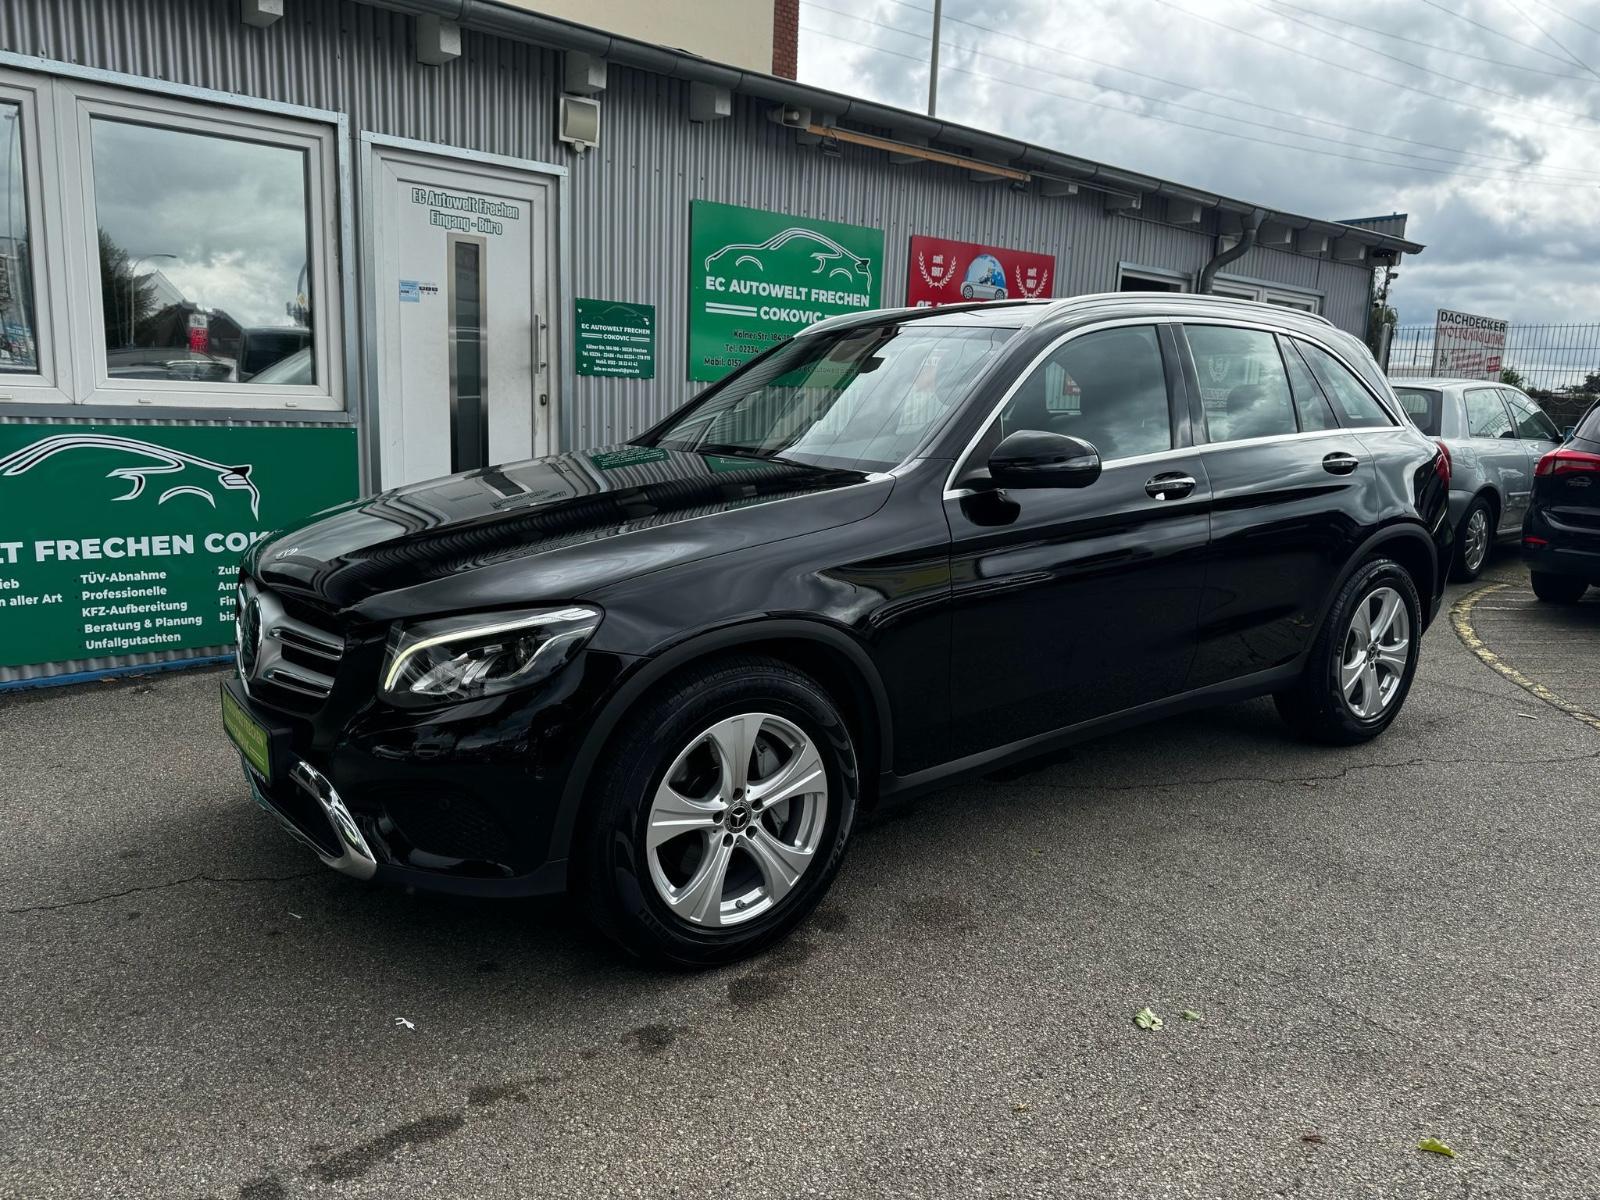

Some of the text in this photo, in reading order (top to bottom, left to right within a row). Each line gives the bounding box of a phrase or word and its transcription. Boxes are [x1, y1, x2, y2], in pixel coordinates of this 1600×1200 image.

[412, 187, 519, 220] EC Autowelt Frechen
[430, 209, 471, 232] Eingang
[478, 217, 503, 235] Büro
[705, 276, 870, 307] EC AUTOWELT FRECHEN
[760, 306, 822, 324] COKOVIC
[1440, 311, 1506, 333] DACHDECKER
[591, 325, 623, 333] AUTOWELT
[623, 327, 651, 335] FRECHEN
[35, 535, 194, 562] FRECHEN
[80, 570, 167, 584] TÜV-Abnahme
[9, 595, 39, 606] aller
[42, 593, 63, 604] Art
[81, 586, 167, 600] Professionelle
[81, 601, 188, 617] KFZ-Aufbereitung
[84, 616, 203, 634] Beratung & Planung
[85, 633, 182, 649] Unfallgutachten
